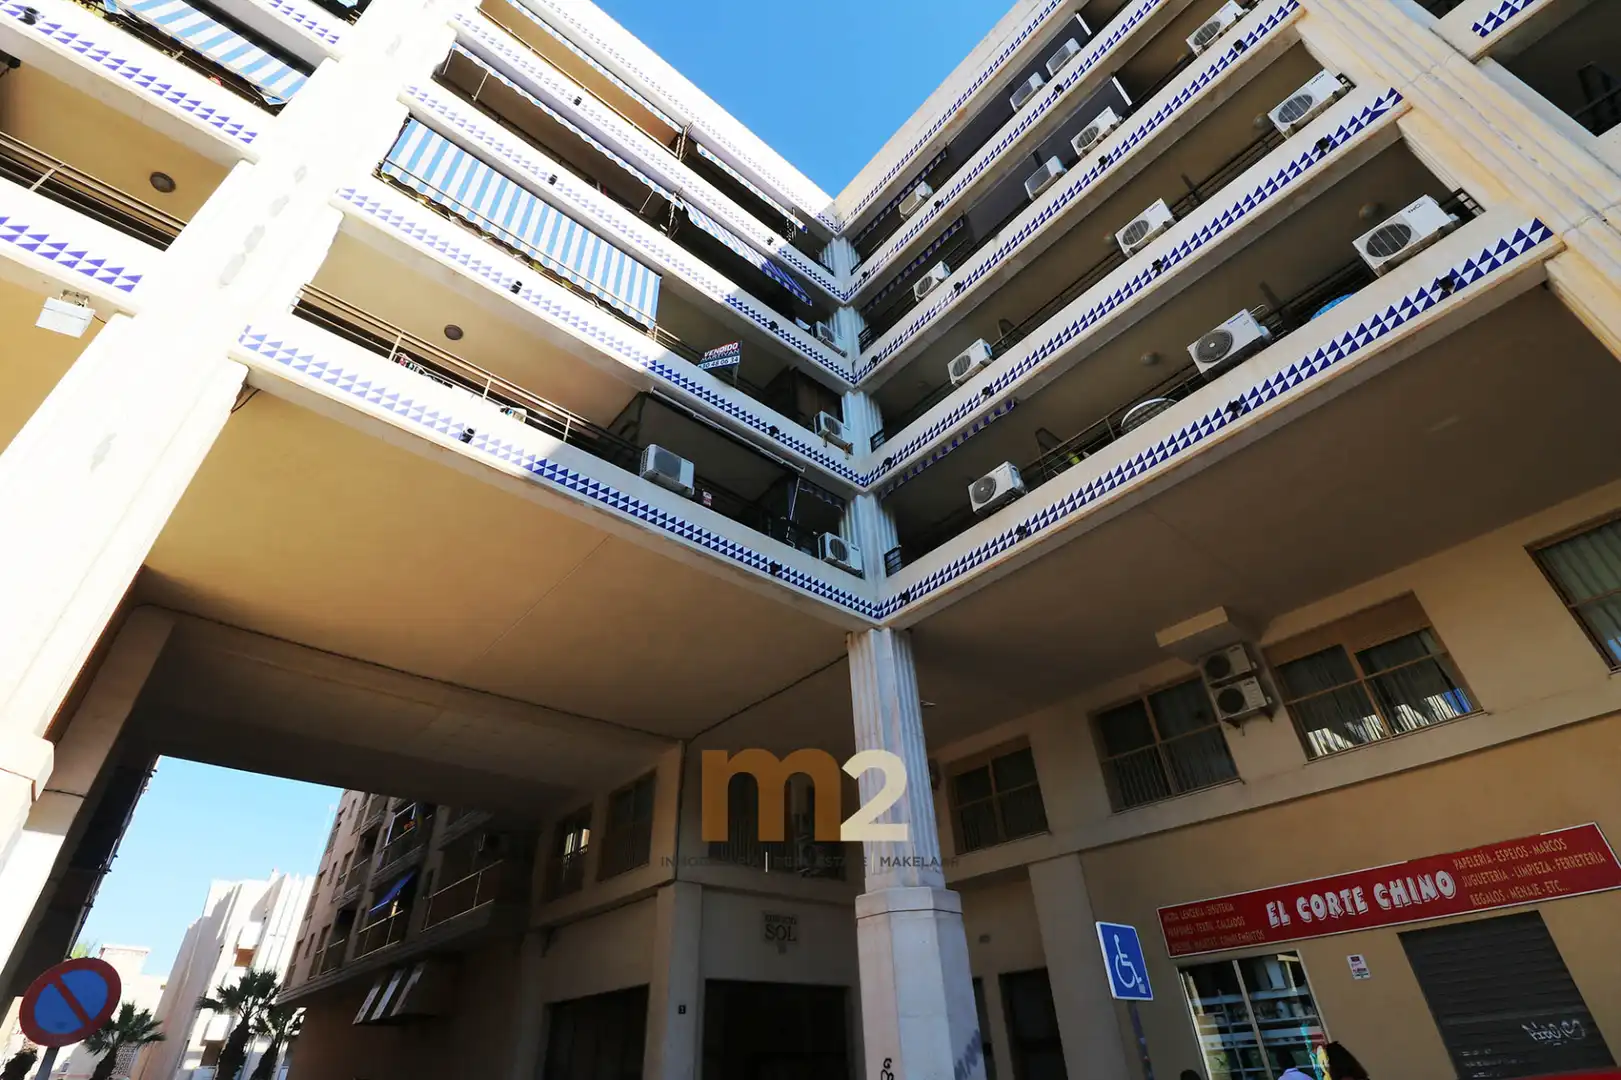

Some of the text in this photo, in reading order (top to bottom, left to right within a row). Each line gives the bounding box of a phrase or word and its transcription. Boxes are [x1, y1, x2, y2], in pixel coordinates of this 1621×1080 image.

[704, 342, 739, 357] VENDIDO
[1453, 851, 1492, 871] PAPELERÍA
[1495, 845, 1530, 863] ESPEJOS
[1532, 838, 1568, 854] MARCOS
[1461, 866, 1508, 888] JUGUETERÍA
[1513, 861, 1551, 879] LIMPIEZA
[1554, 848, 1607, 871] FERRETERÍA
[1266, 870, 1456, 928] EL CORTE CHINO
[1469, 889, 1506, 907] REGALOS
[1509, 882, 1542, 899] MENAJE
[765, 923, 797, 942] SOL
